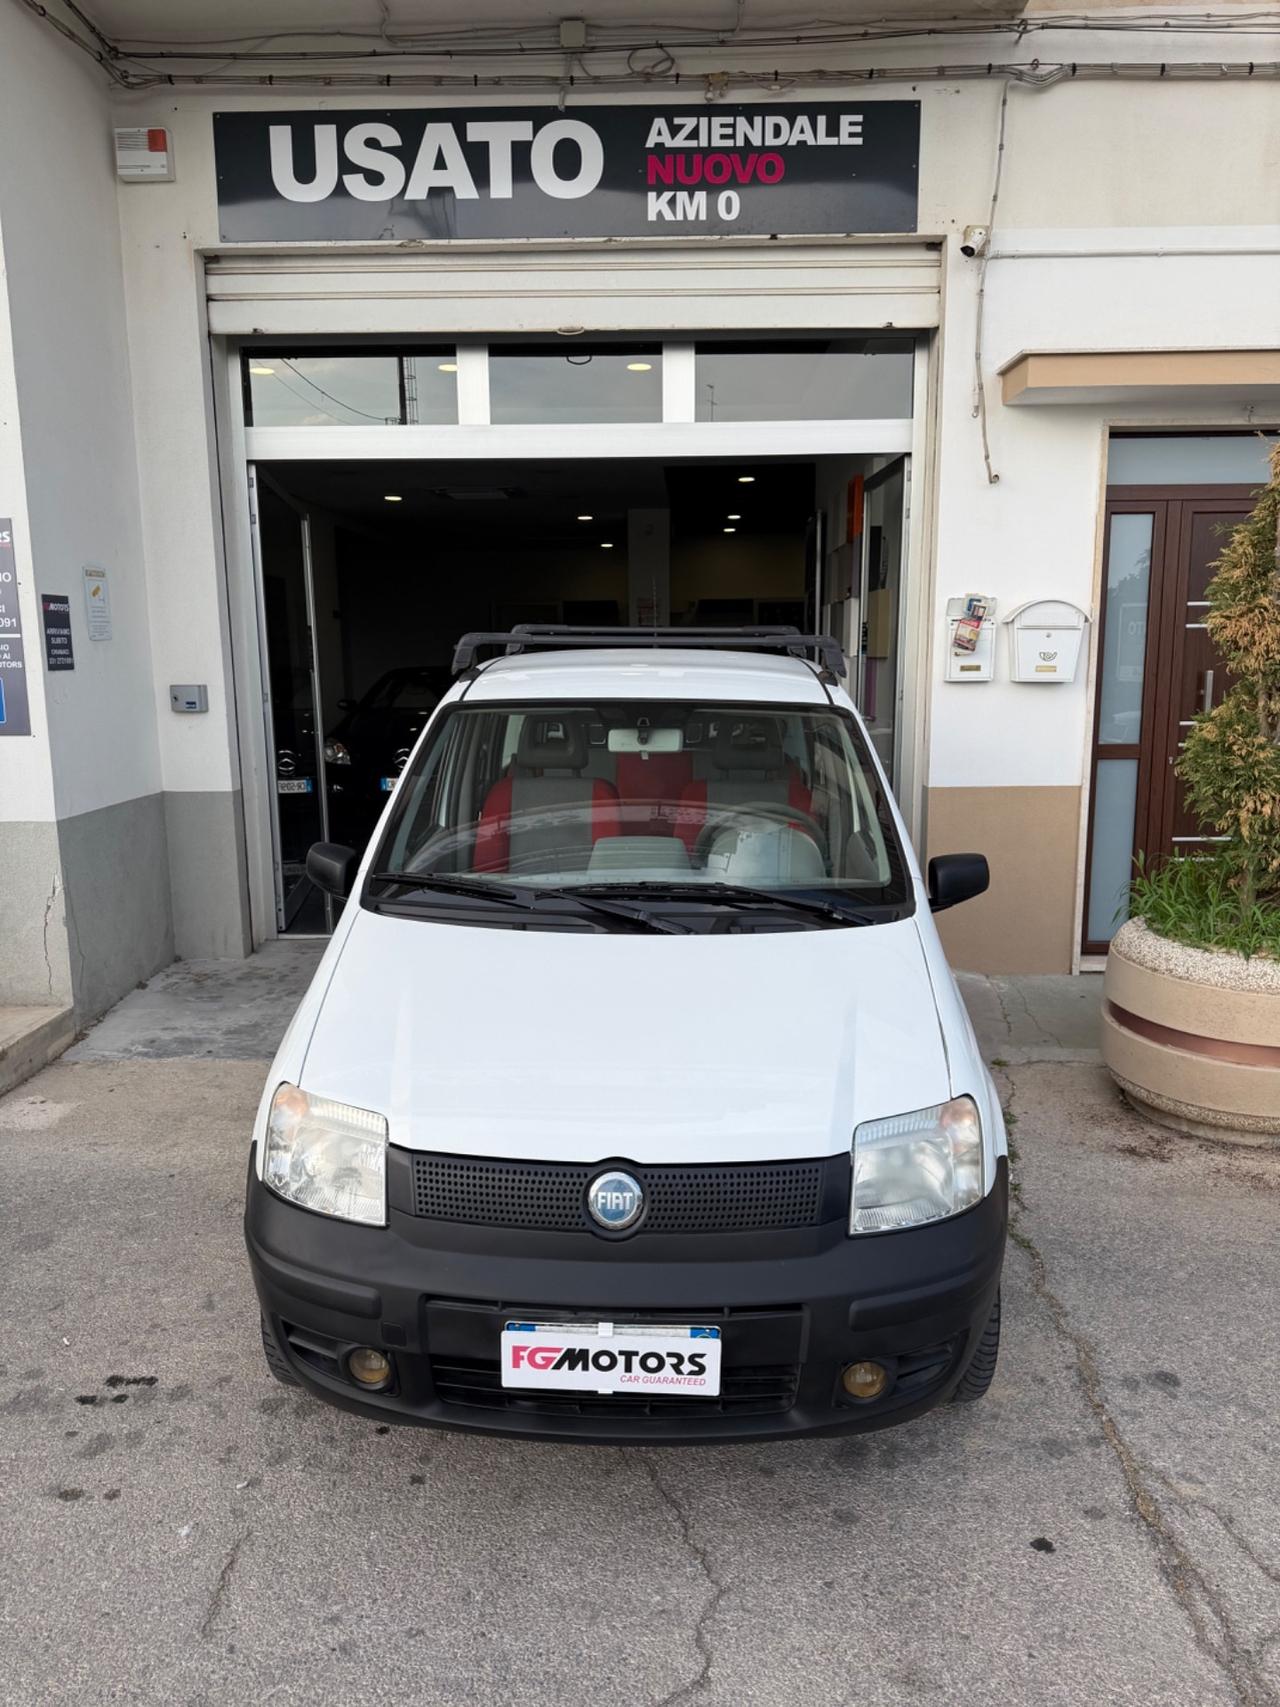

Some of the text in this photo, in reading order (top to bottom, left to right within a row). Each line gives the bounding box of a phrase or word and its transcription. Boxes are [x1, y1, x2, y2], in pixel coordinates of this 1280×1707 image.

[645, 114, 864, 148] AZIENDALE
[269, 119, 604, 203] USATO
[646, 153, 785, 185] NUOVO
[647, 190, 741, 221] KM 0
[597, 1191, 633, 1210] FIAT
[512, 1345, 707, 1377] FGMOTORS
[620, 1374, 706, 1387] CAR GUARANTEED
